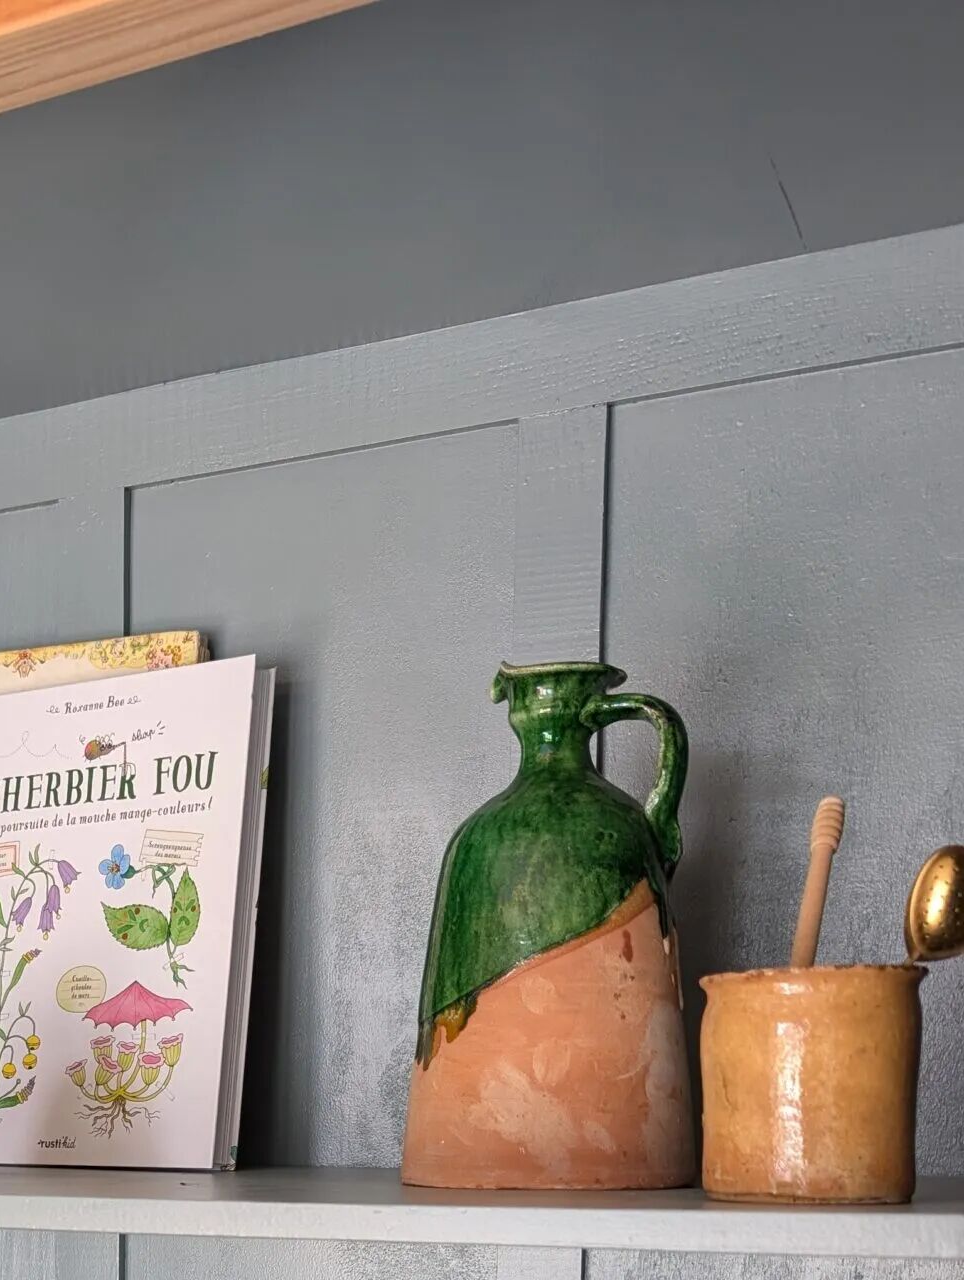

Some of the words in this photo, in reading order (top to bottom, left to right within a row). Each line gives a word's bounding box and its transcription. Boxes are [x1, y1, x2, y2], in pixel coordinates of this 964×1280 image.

[64, 701, 104, 715] Roxanne
[106, 695, 125, 710] Bee
[153, 751, 218, 796] FOU
[0, 816, 49, 838] poursuite
[51, 814, 64, 827] de
[66, 812, 77, 826] la
[79, 807, 117, 825] mouche
